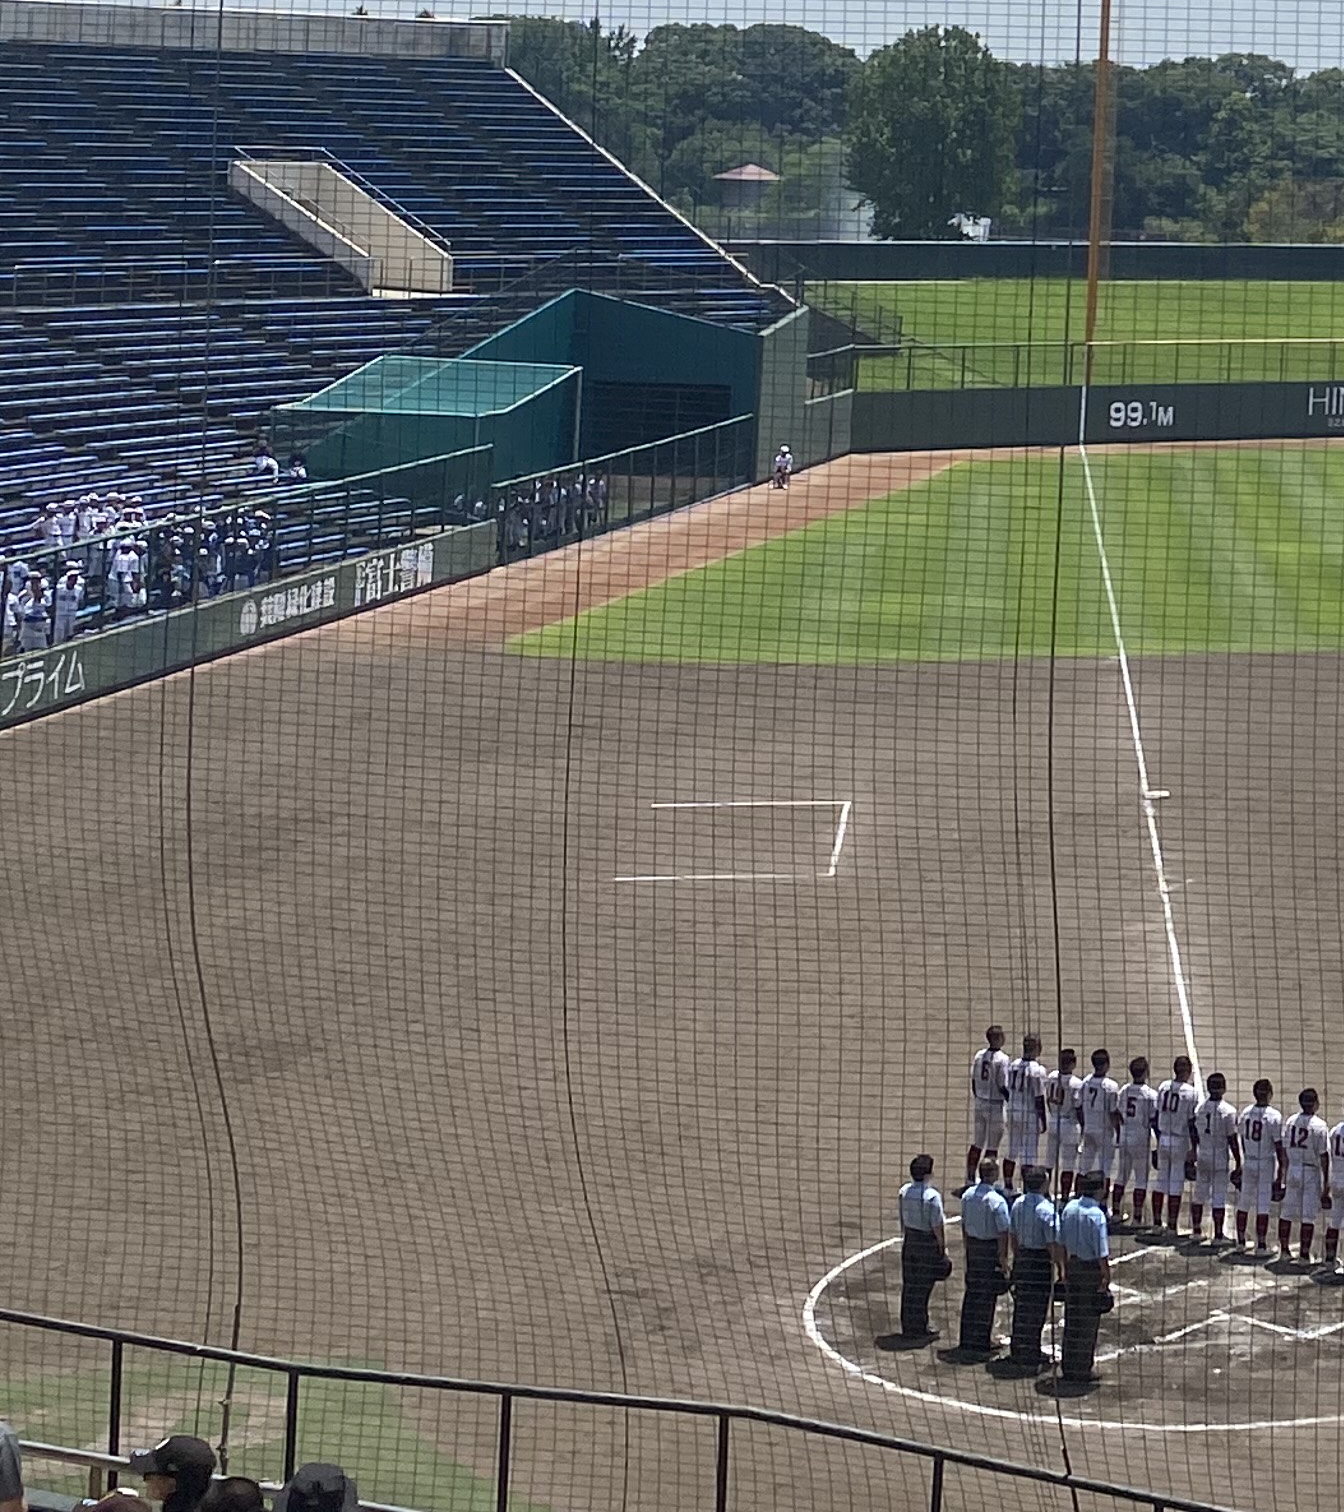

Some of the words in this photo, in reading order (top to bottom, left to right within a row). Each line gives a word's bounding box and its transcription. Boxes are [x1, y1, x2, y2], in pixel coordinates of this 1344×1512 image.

[1, 650, 85, 716] プライム
[1090, 1087, 1098, 1108] 7
[1126, 1097, 1136, 1118] 5
[1162, 1090, 1180, 1113] 10
[1204, 1113, 1211, 1134] 1
[1290, 1125, 1309, 1149] 12
